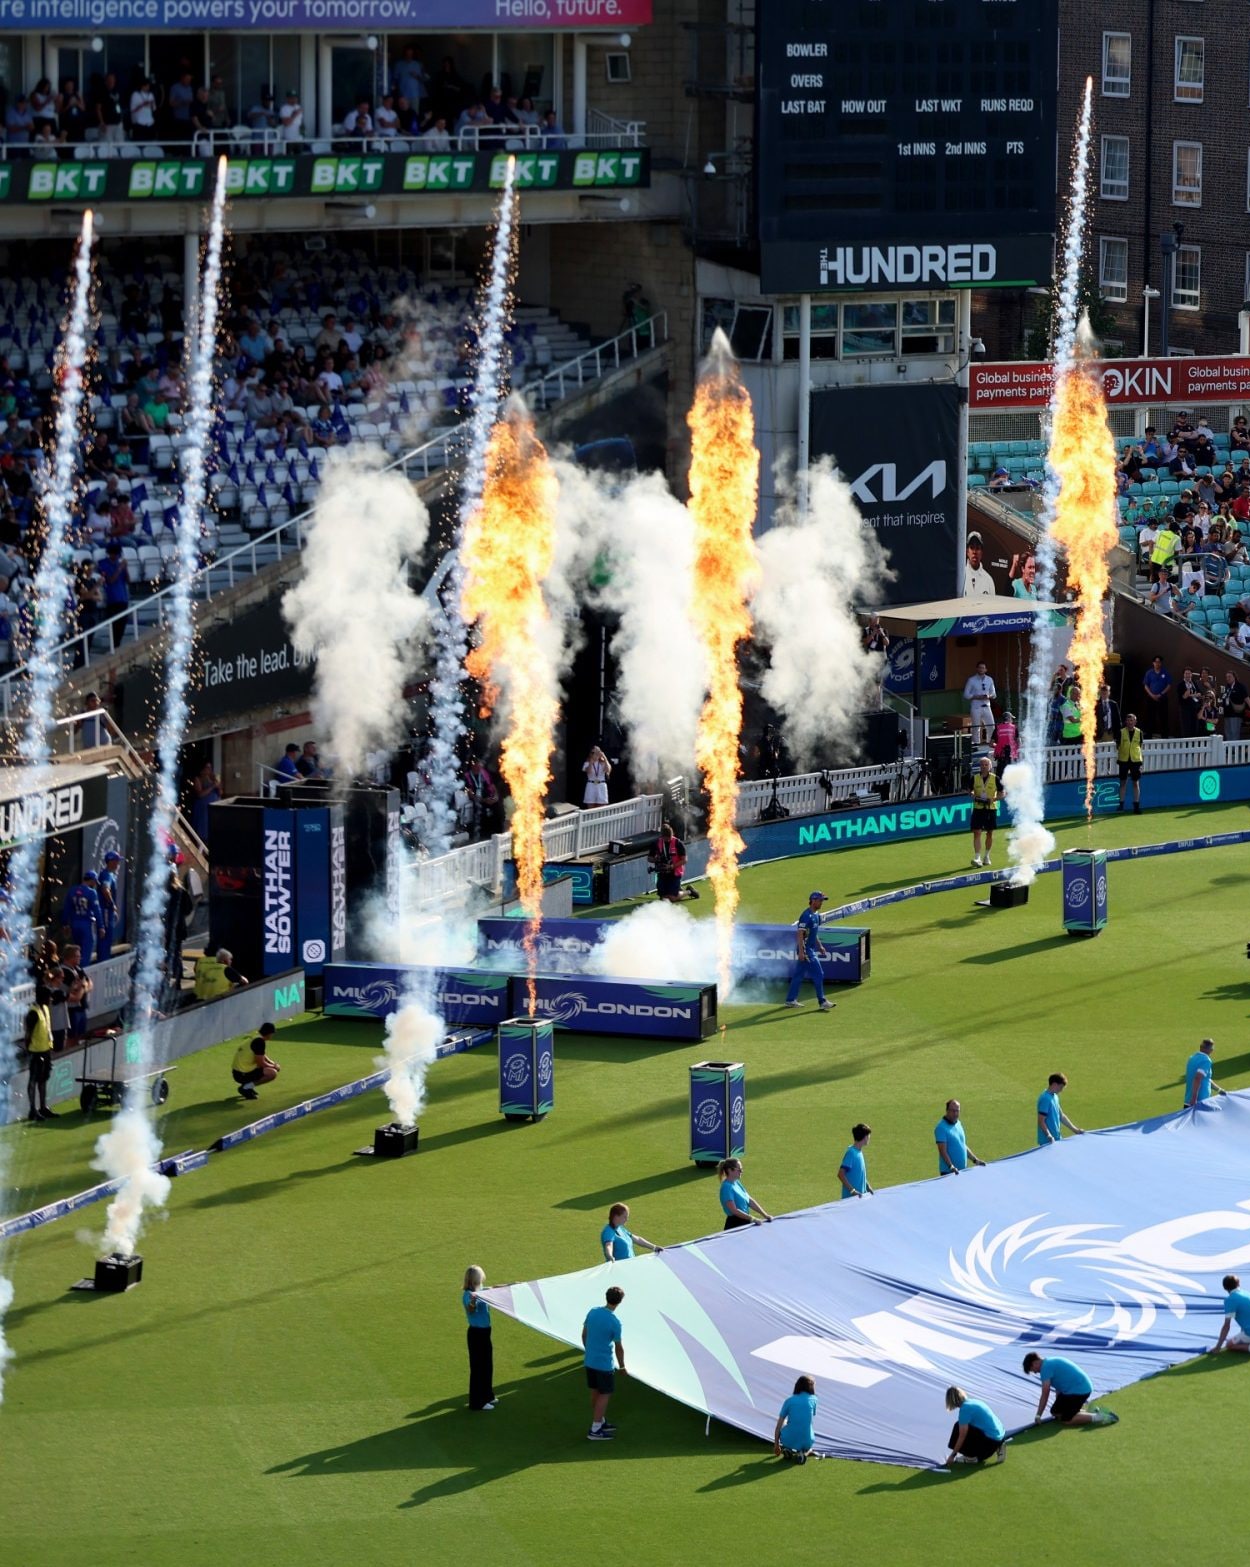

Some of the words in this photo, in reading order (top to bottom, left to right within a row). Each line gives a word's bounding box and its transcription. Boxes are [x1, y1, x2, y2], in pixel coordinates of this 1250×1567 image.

[31, 0, 158, 24] intelligence
[164, 0, 244, 23] powers
[251, 0, 295, 23] your
[305, 0, 416, 17] tomorrow.
[496, 0, 551, 18] Hello,
[557, 0, 622, 16] future.
[786, 43, 828, 58] BOWLER
[790, 74, 823, 88] OVERS
[781, 101, 806, 114] LAST
[807, 100, 827, 114] BAT
[841, 100, 865, 113] HOW
[867, 99, 887, 113] OUT
[915, 99, 939, 112] LAST
[941, 99, 962, 112] WKT
[981, 99, 1007, 112] RUNS
[1009, 98, 1034, 112] REQD
[897, 143, 911, 156] 1st
[913, 142, 936, 156] INNS
[945, 142, 962, 155] 2nd
[964, 141, 987, 155] INNS
[1006, 141, 1024, 154] PTS
[224, 165, 294, 188] BKT
[313, 163, 382, 186] BKT
[405, 161, 473, 184] BKT
[573, 157, 640, 180] BKT
[31, 169, 105, 192] BKT
[130, 168, 203, 190] BKT
[820, 243, 997, 285] HUNDRED
[976, 372, 1010, 384] Global
[1012, 370, 1057, 383] business
[1188, 366, 1222, 378] Global
[1102, 367, 1172, 397] OKIN
[1188, 380, 1238, 393] payments
[976, 386, 1027, 400] payments
[883, 513, 904, 527] that
[906, 511, 945, 528] inspires
[987, 617, 1032, 627] LONDON
[203, 657, 233, 688] Take
[236, 653, 257, 680] the
[260, 643, 290, 675] lead.
[799, 813, 897, 845] NATHAN
[900, 801, 1000, 830] SOWT
[264, 829, 279, 953] NATHAN
[278, 831, 291, 954] SOWTER
[742, 949, 851, 963] LONON
[581, 1001, 692, 1019] LONDON
